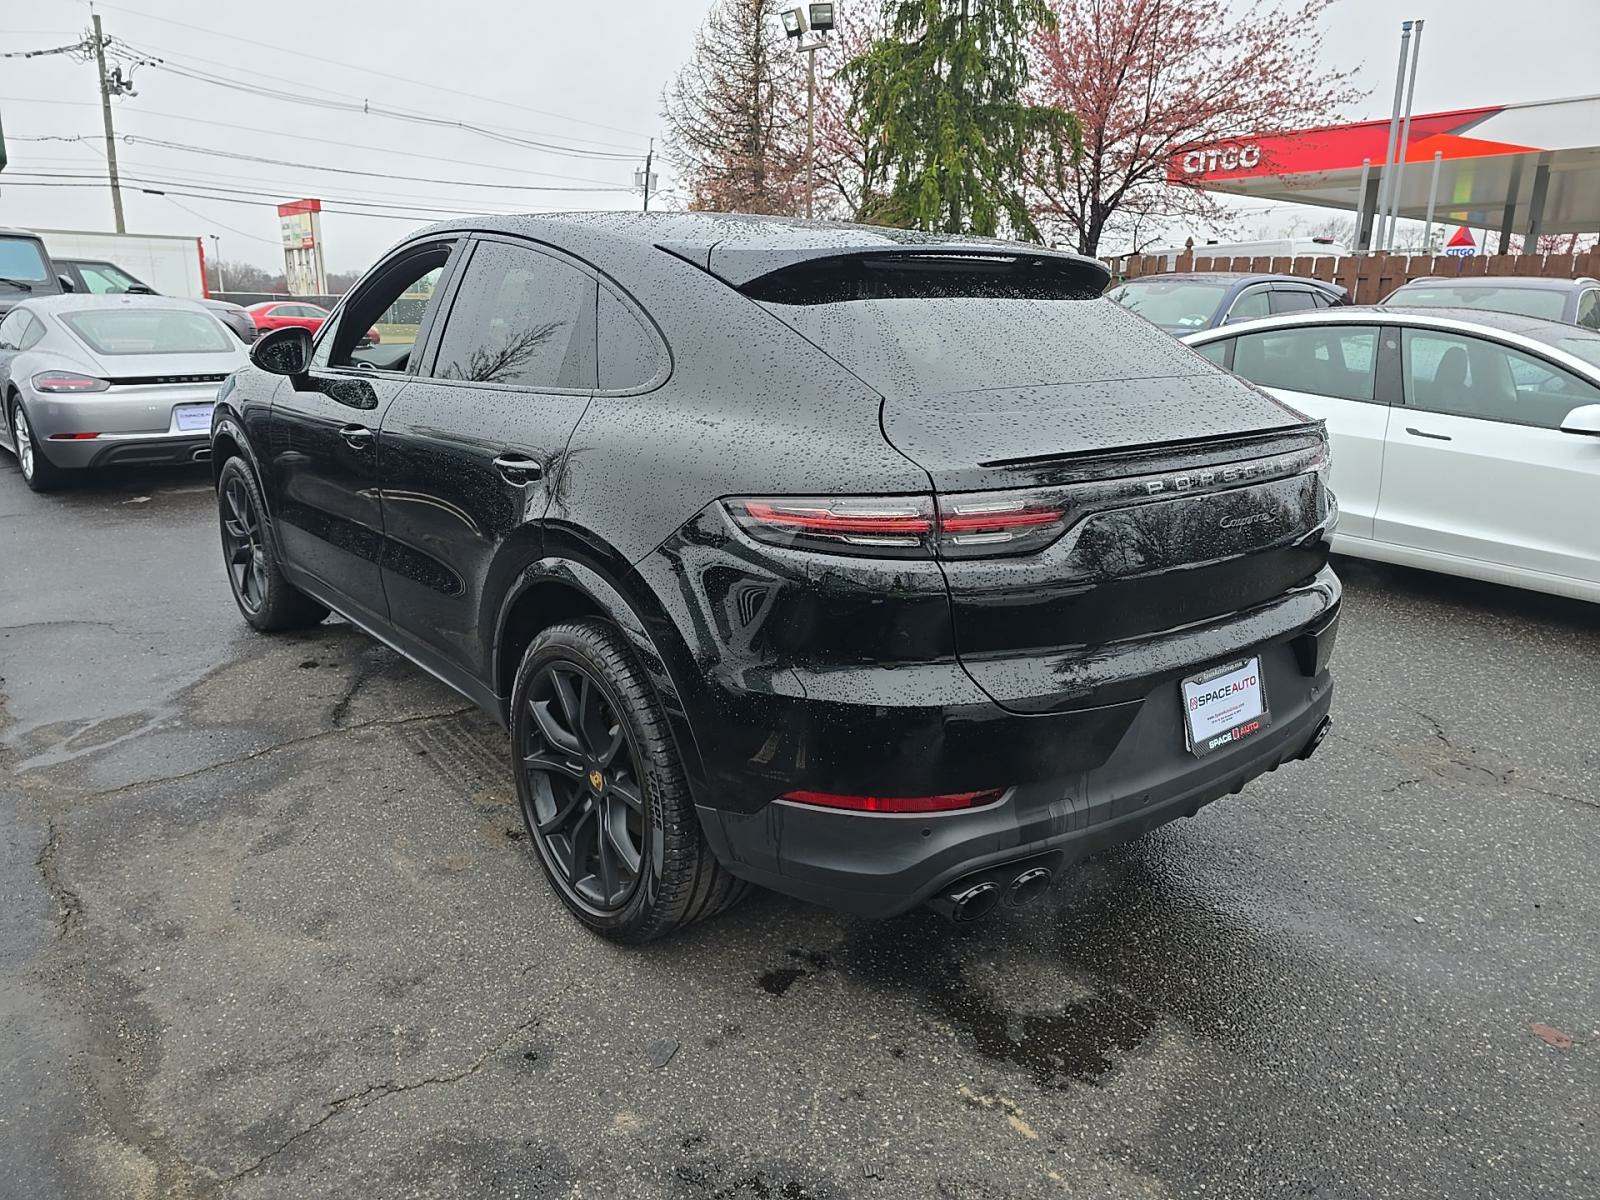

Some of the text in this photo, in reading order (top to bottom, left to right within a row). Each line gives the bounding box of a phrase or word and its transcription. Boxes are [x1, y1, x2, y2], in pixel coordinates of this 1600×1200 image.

[1183, 144, 1260, 173] CITGO
[1446, 248, 1475, 257] CITGO
[1147, 457, 1293, 495] PORSCHE
[1220, 513, 1270, 532] Cayenne
[1208, 721, 1260, 749] SPACE AUTO
